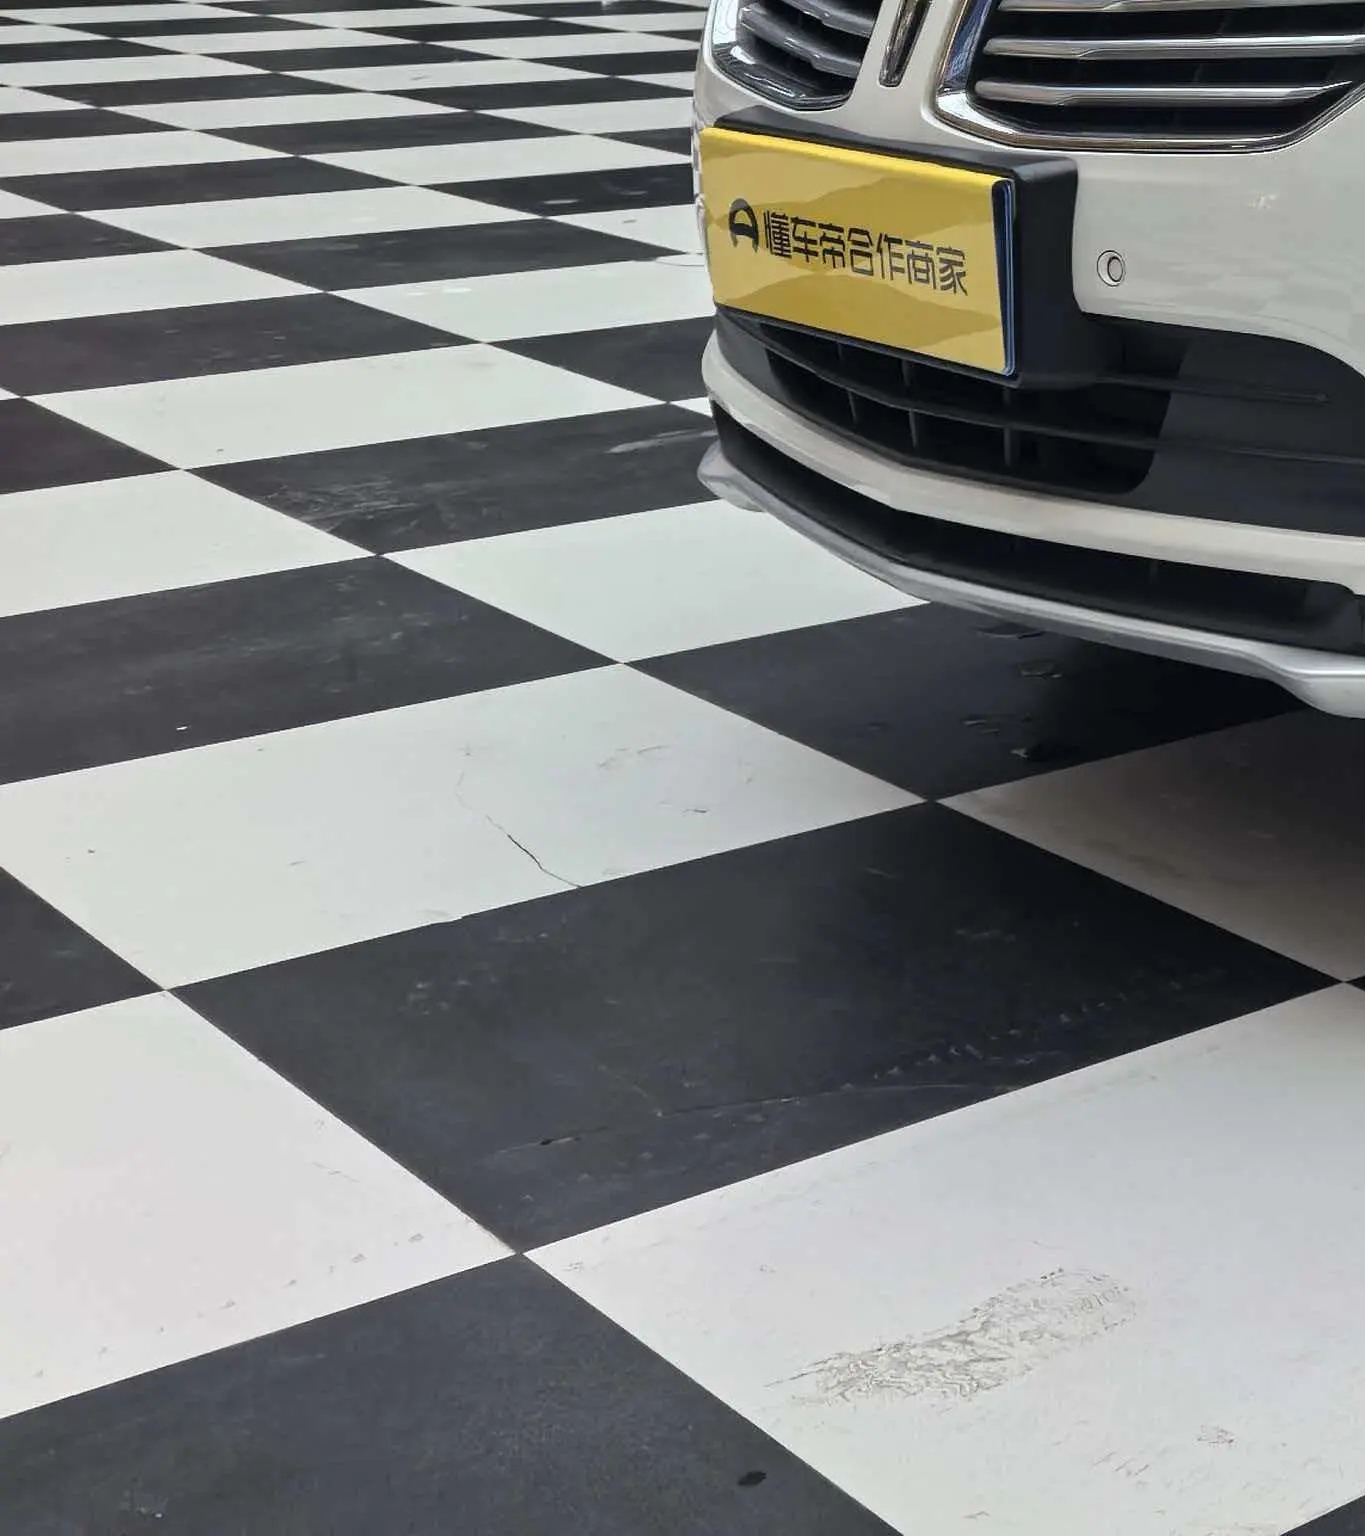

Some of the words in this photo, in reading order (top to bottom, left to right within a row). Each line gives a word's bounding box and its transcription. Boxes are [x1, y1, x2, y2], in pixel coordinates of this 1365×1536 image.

[763, 209, 969, 297] 懂车帝合作商家
